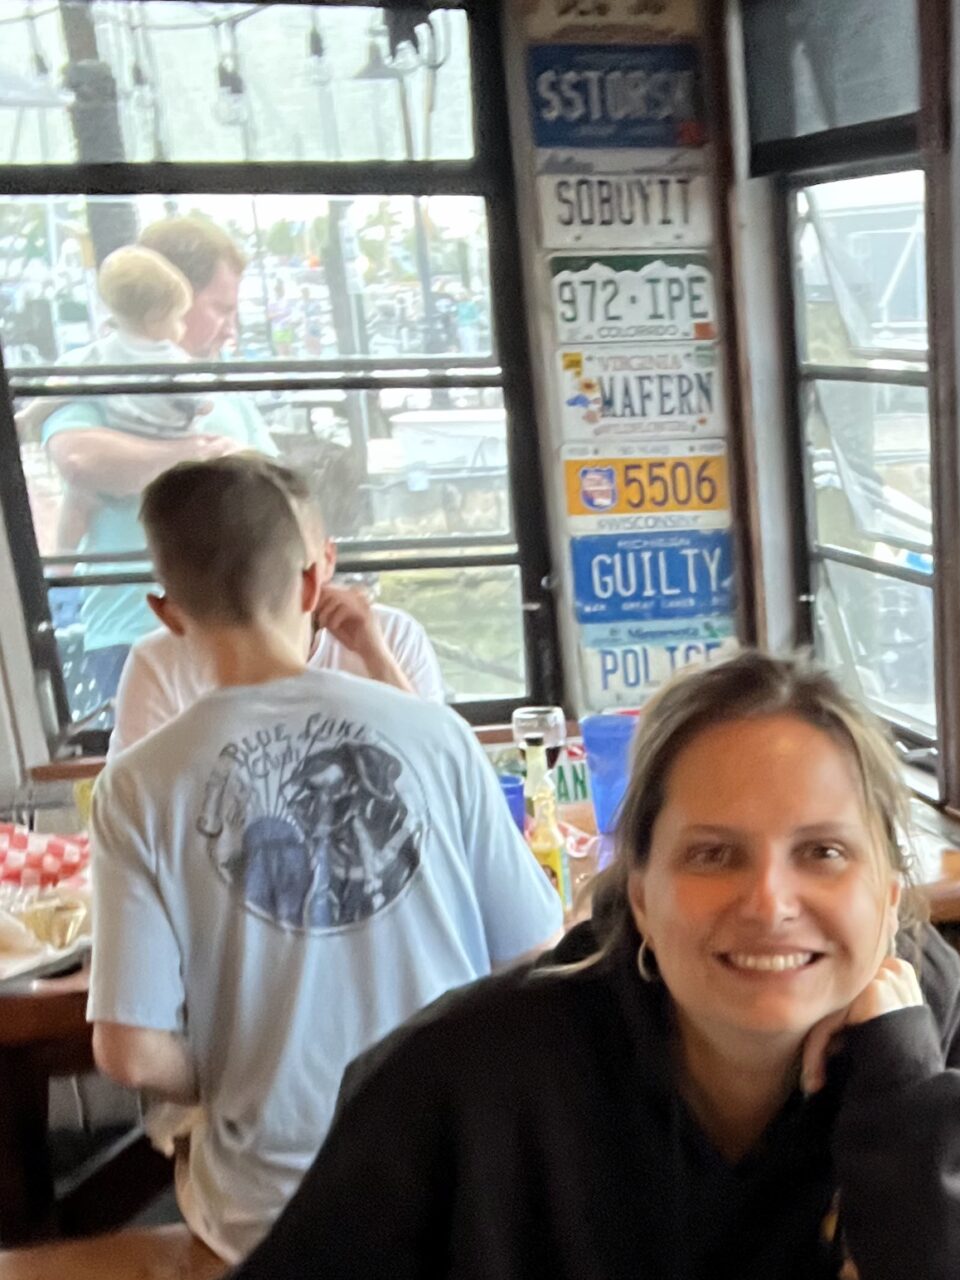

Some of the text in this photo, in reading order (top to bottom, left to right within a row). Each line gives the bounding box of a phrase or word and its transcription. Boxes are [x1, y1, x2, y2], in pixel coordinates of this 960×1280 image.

[556, 177, 690, 226] SOBUYIT
[624, 460, 718, 509] 5506
[591, 547, 722, 599] GUILTY
